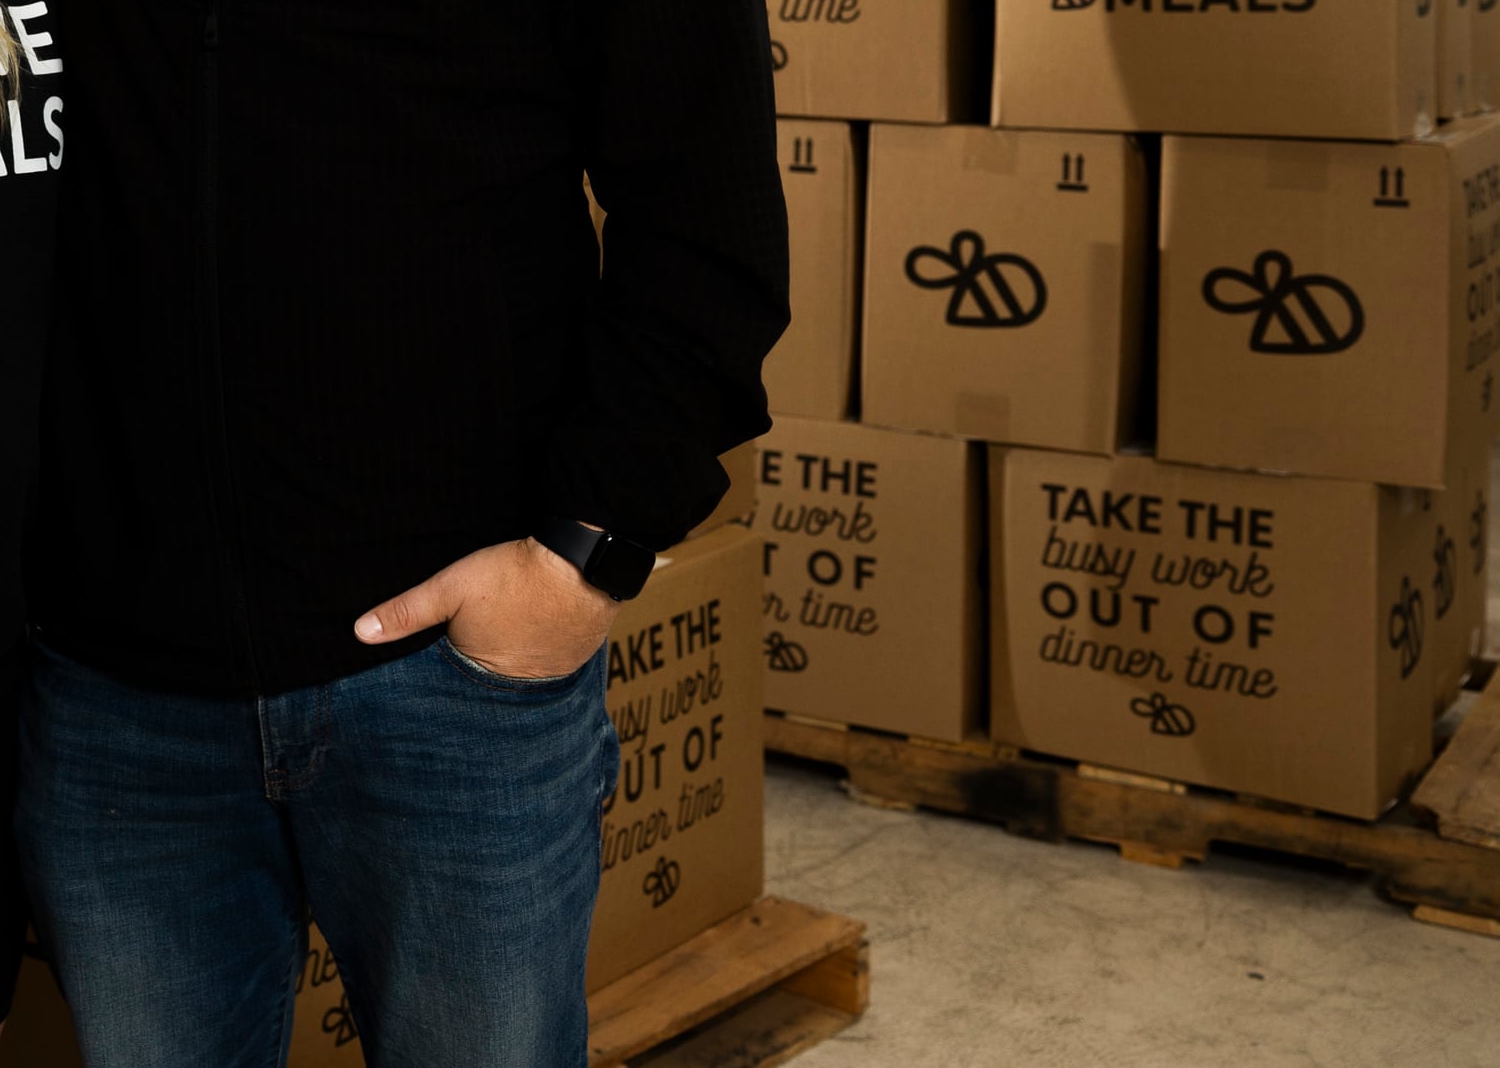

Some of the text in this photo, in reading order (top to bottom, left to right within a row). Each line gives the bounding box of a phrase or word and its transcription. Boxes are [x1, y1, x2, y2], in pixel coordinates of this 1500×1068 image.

[796, 453, 879, 498] THE
[772, 501, 878, 543] work
[1041, 483, 1275, 548] TAKE THE
[807, 549, 878, 590] OF
[1041, 525, 1275, 598] busy work
[606, 624, 664, 690] AKE
[670, 599, 721, 660] THE
[800, 589, 880, 637] time
[1040, 582, 1275, 649] OUT OF
[1040, 625, 1278, 700] dinner time
[611, 650, 723, 754] usy work
[603, 714, 723, 816] UT OF
[677, 777, 724, 833] time
